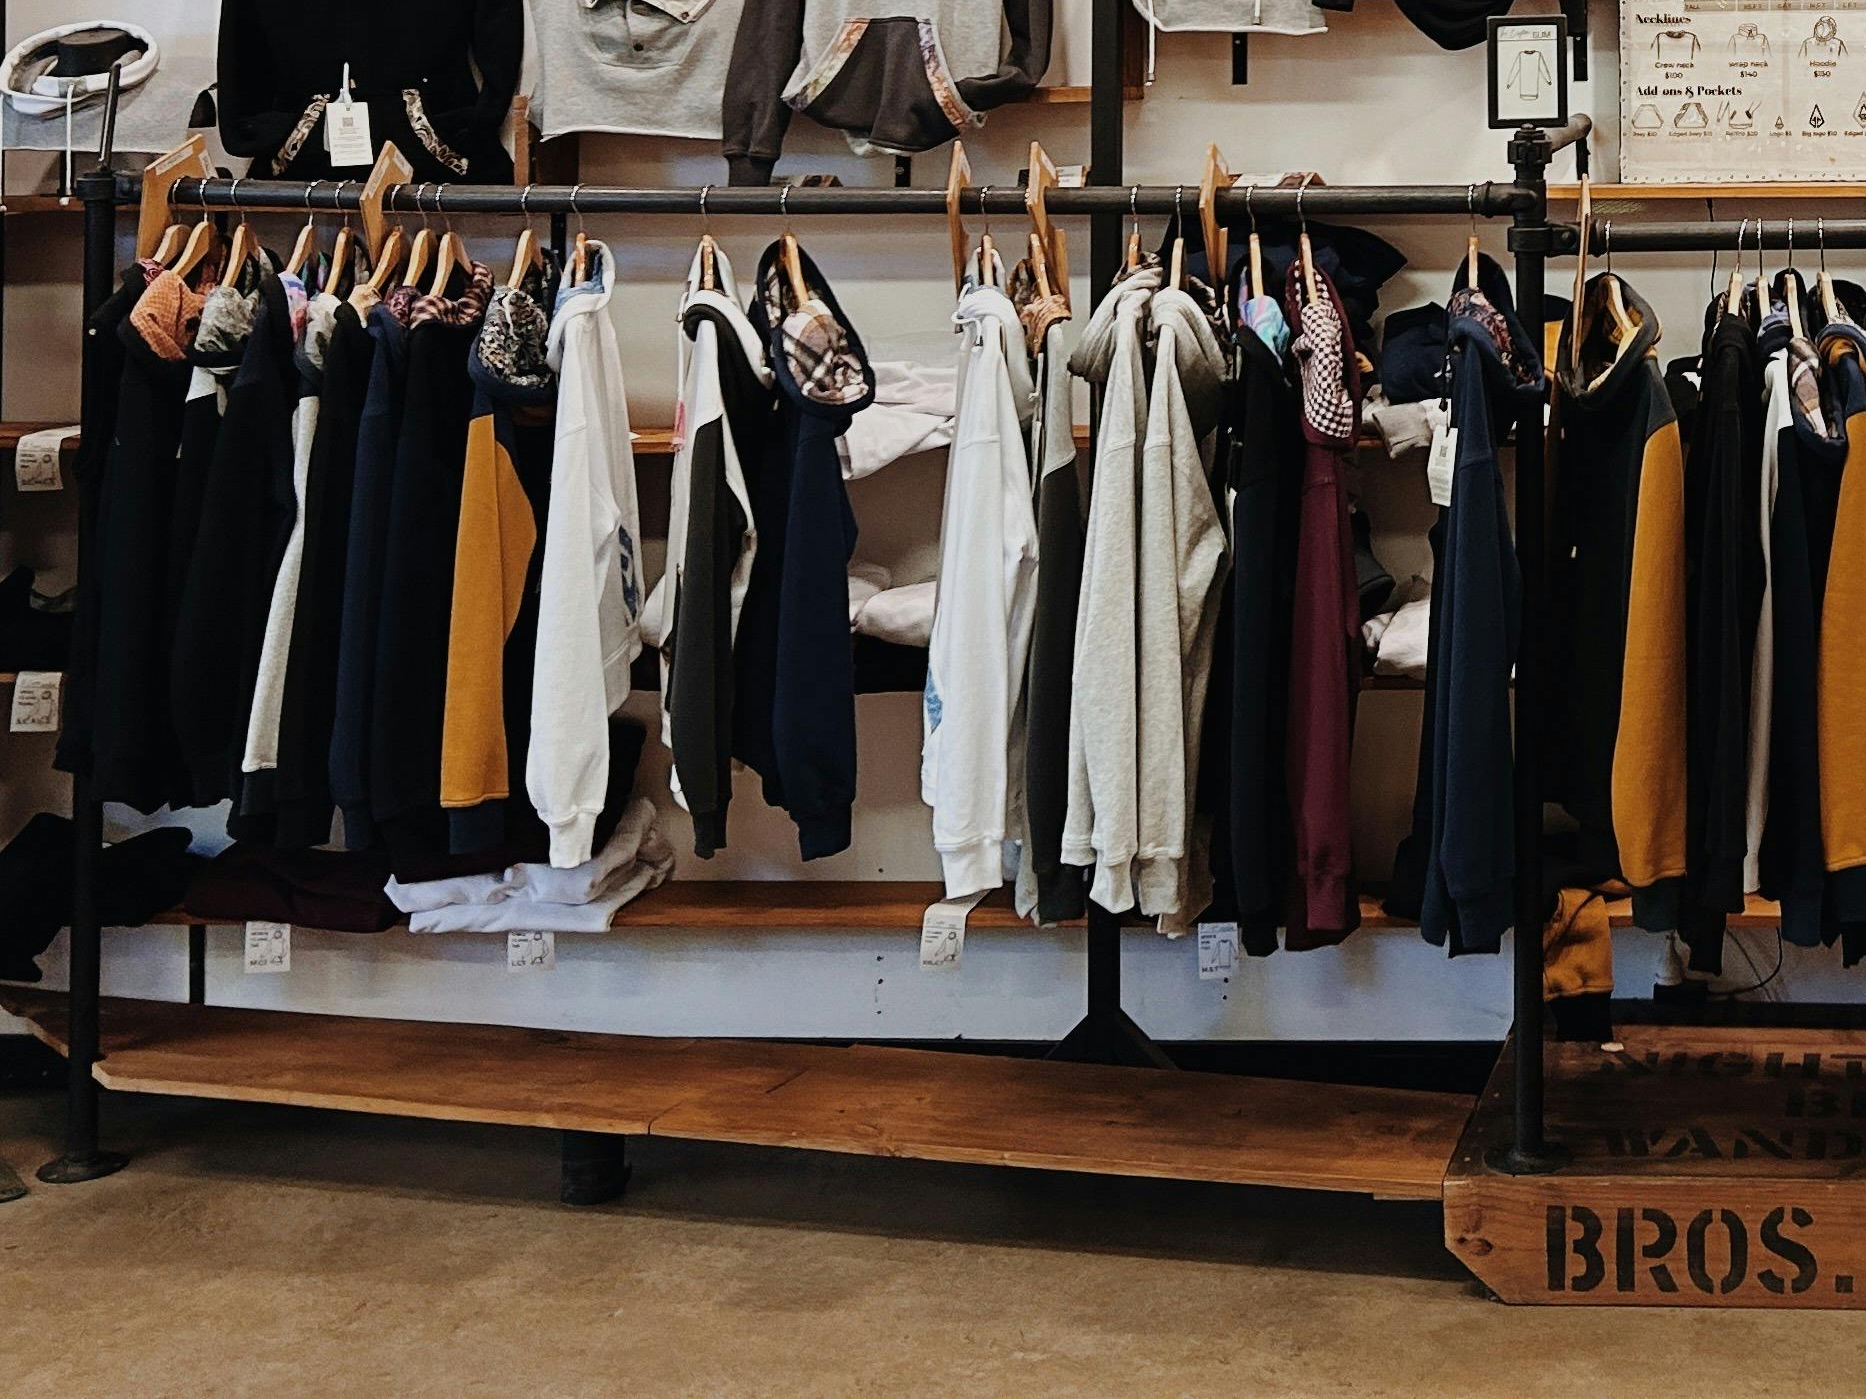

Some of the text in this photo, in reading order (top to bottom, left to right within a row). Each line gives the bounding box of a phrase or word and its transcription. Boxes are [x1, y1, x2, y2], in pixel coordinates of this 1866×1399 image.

[1635, 13, 1692, 24] Necklines
[1697, 85, 1742, 96] Pockets
[1545, 1204, 1855, 1296] BROS.
